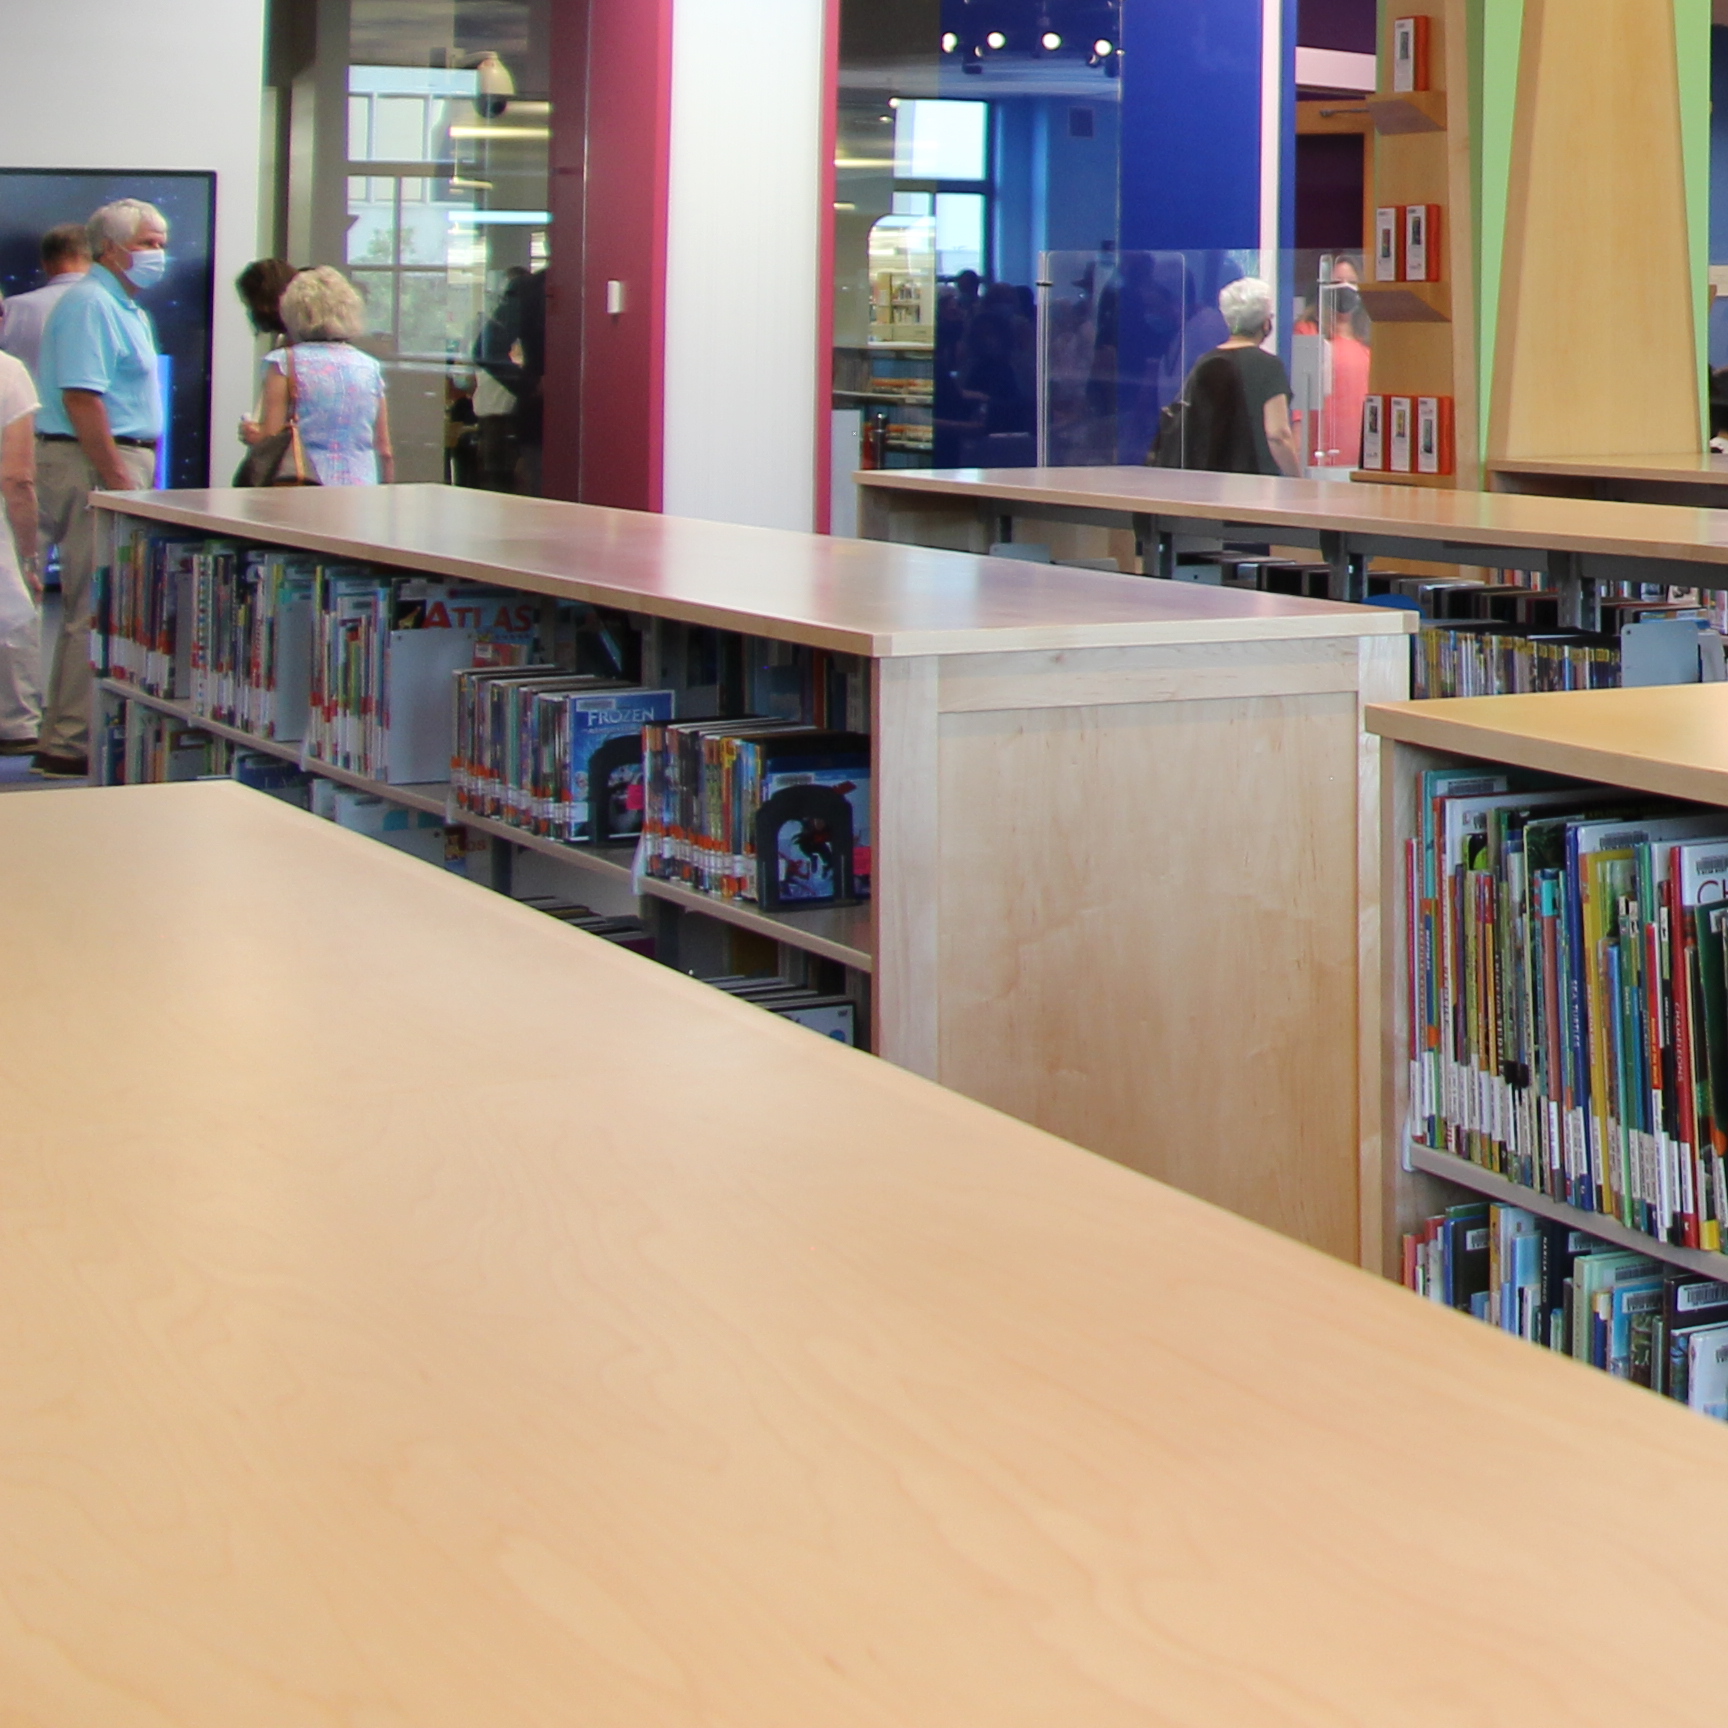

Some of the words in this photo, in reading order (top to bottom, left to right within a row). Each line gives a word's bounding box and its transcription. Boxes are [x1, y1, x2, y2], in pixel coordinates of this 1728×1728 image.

[421, 601, 534, 632] ATLAS
[588, 707, 655, 726] FROZEN
[1572, 1004, 1580, 1048] TURTLES
[1674, 1001, 1684, 1083] CHAMELEONS
